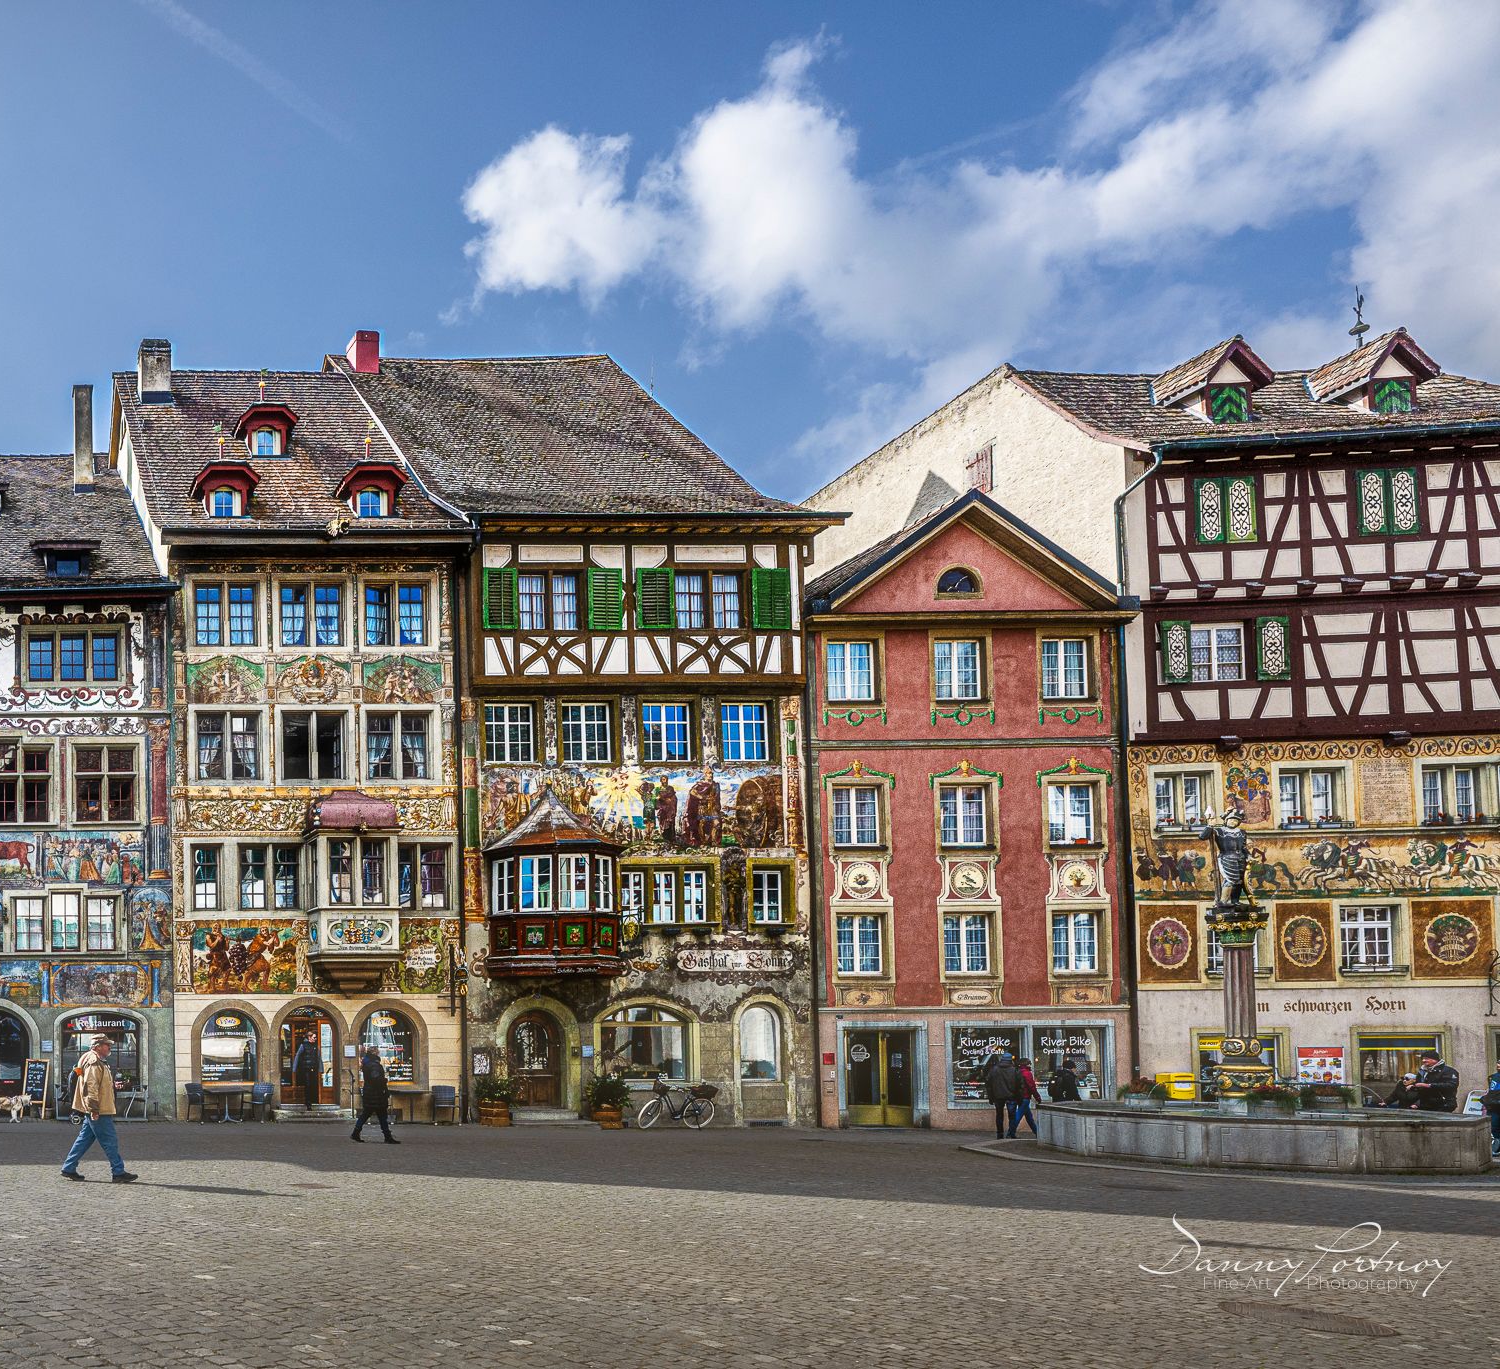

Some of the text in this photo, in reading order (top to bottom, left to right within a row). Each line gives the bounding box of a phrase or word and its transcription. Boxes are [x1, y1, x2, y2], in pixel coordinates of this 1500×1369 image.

[683, 952, 730, 970] Gasthof
[746, 951, 791, 969] Sonne
[1283, 998, 1352, 1015] schwarzen
[1365, 995, 1407, 1015] Horn
[78, 1019, 126, 1027] Restaurant
[960, 1036, 1011, 1047] River Bike
[1040, 1036, 1092, 1047] River Bike
[962, 1048, 984, 1056] Cycling
[1071, 1047, 1086, 1055] Café
